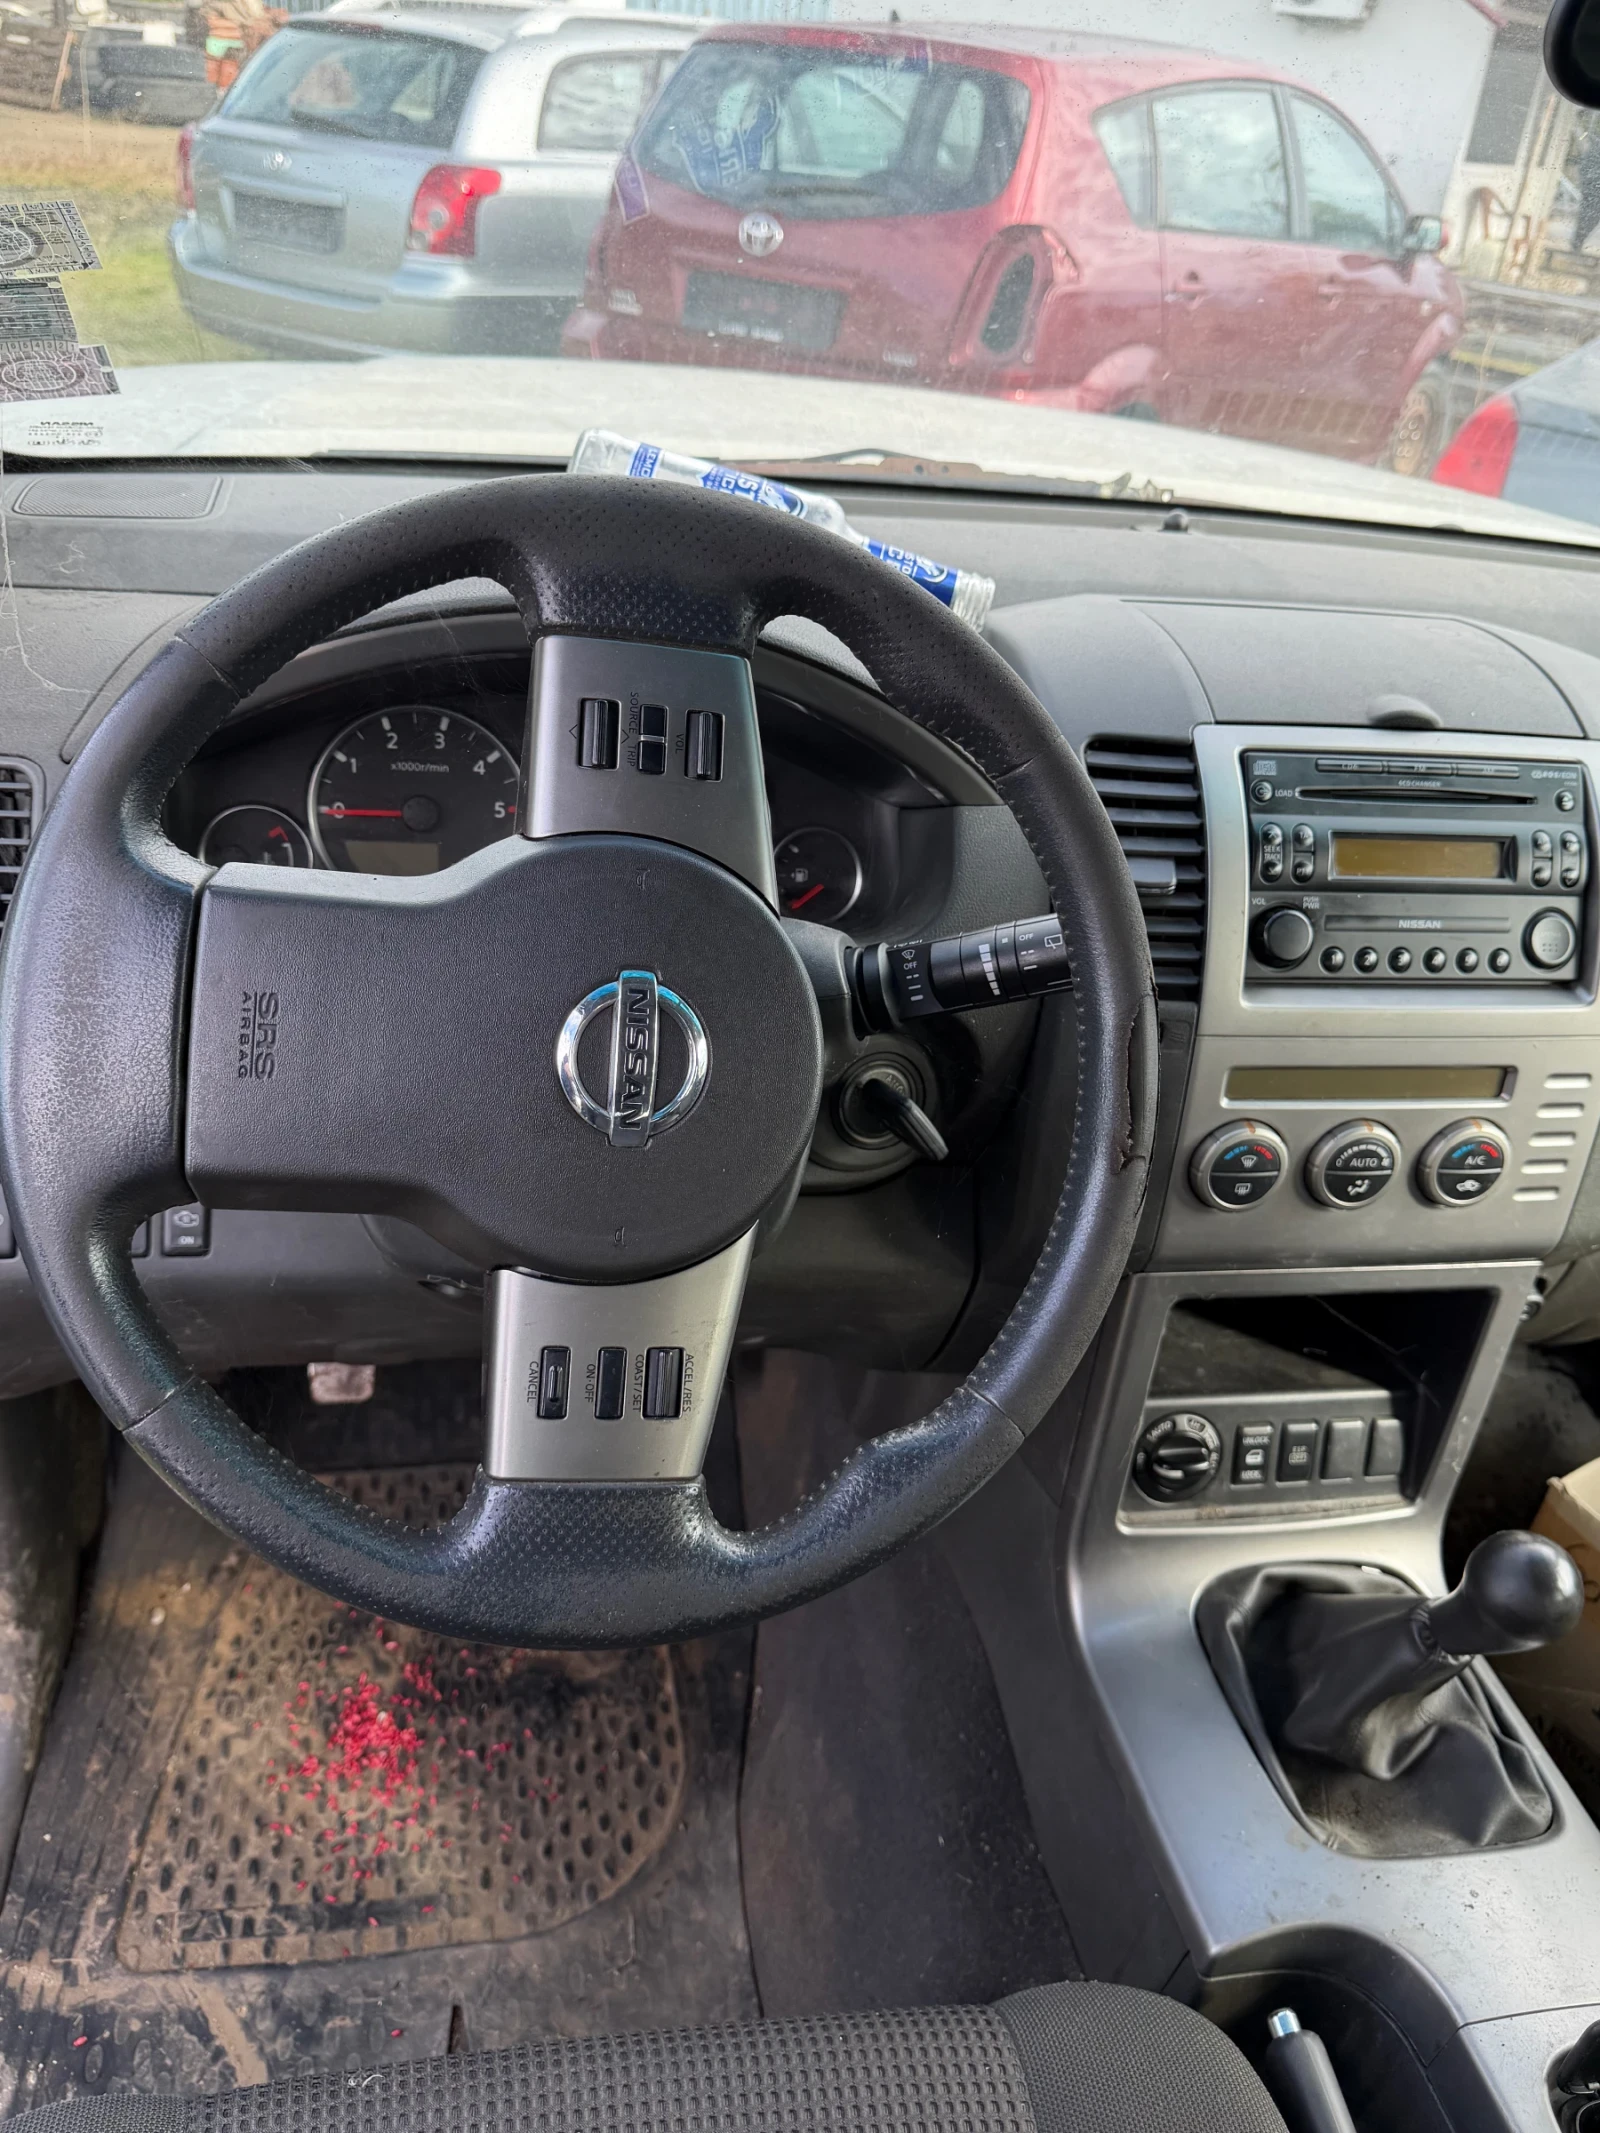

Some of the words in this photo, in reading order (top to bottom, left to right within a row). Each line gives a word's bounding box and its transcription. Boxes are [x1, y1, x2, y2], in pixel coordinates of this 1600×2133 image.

[640, 448, 658, 478] LEMO
[629, 691, 639, 734] SOURCE
[387, 733, 398, 749] 2
[435, 733, 445, 749] 3
[675, 733, 684, 754] VOL
[627, 745, 636, 767] TRIP
[351, 758, 357, 773] 1
[473, 759, 485, 775] 4
[1275, 789, 1293, 797] LOAD
[494, 802, 505, 818] 5
[1252, 897, 1266, 905] VOL
[1399, 919, 1441, 928] NISSAN
[1019, 932, 1034, 941] OFF
[903, 961, 918, 970] OFF
[1364, 955, 1370, 965] 2
[1431, 955, 1438, 964] 4
[238, 990, 252, 1079] AIRBAG
[255, 992, 280, 1079] SRS
[619, 988, 649, 1129] NISSAN
[1349, 1157, 1378, 1167] AUTO
[1464, 1155, 1486, 1166] A/C
[179, 1235, 195, 1244] ON
[526, 1361, 539, 1403] CANCEL
[682, 1354, 694, 1412] ACCEL/RES
